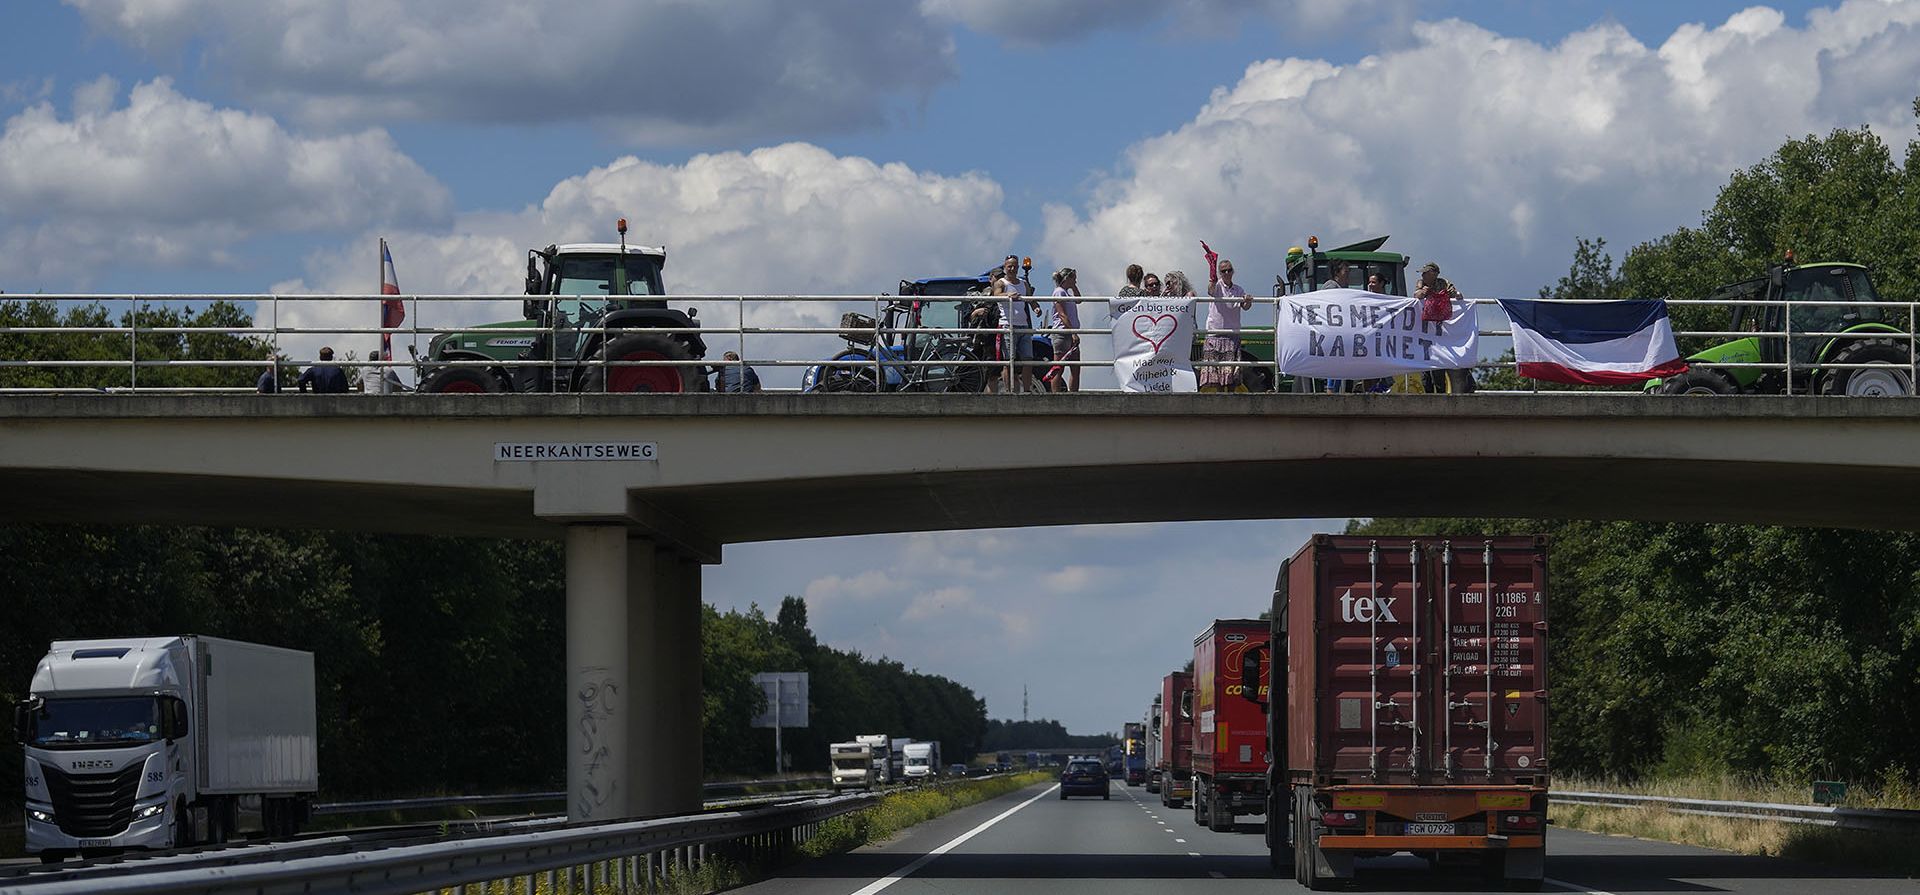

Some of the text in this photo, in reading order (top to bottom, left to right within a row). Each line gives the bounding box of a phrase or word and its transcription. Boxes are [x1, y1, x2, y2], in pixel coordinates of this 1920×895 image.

[1118, 303, 1189, 314] Geen big reset
[1132, 367, 1177, 381] Vrijheid &
[501, 445, 653, 458] NEERKANTSEWEG
[1460, 592, 1541, 604] TGHU 111865 4
[1340, 588, 1398, 623] tex
[1495, 606, 1517, 618] 22G1
[1470, 638, 1482, 647] WT.
[1453, 652, 1479, 661] PAYLOAD
[1464, 665, 1478, 675] CAP.
[147, 771, 164, 783] 585
[1409, 823, 1425, 834] FGW
